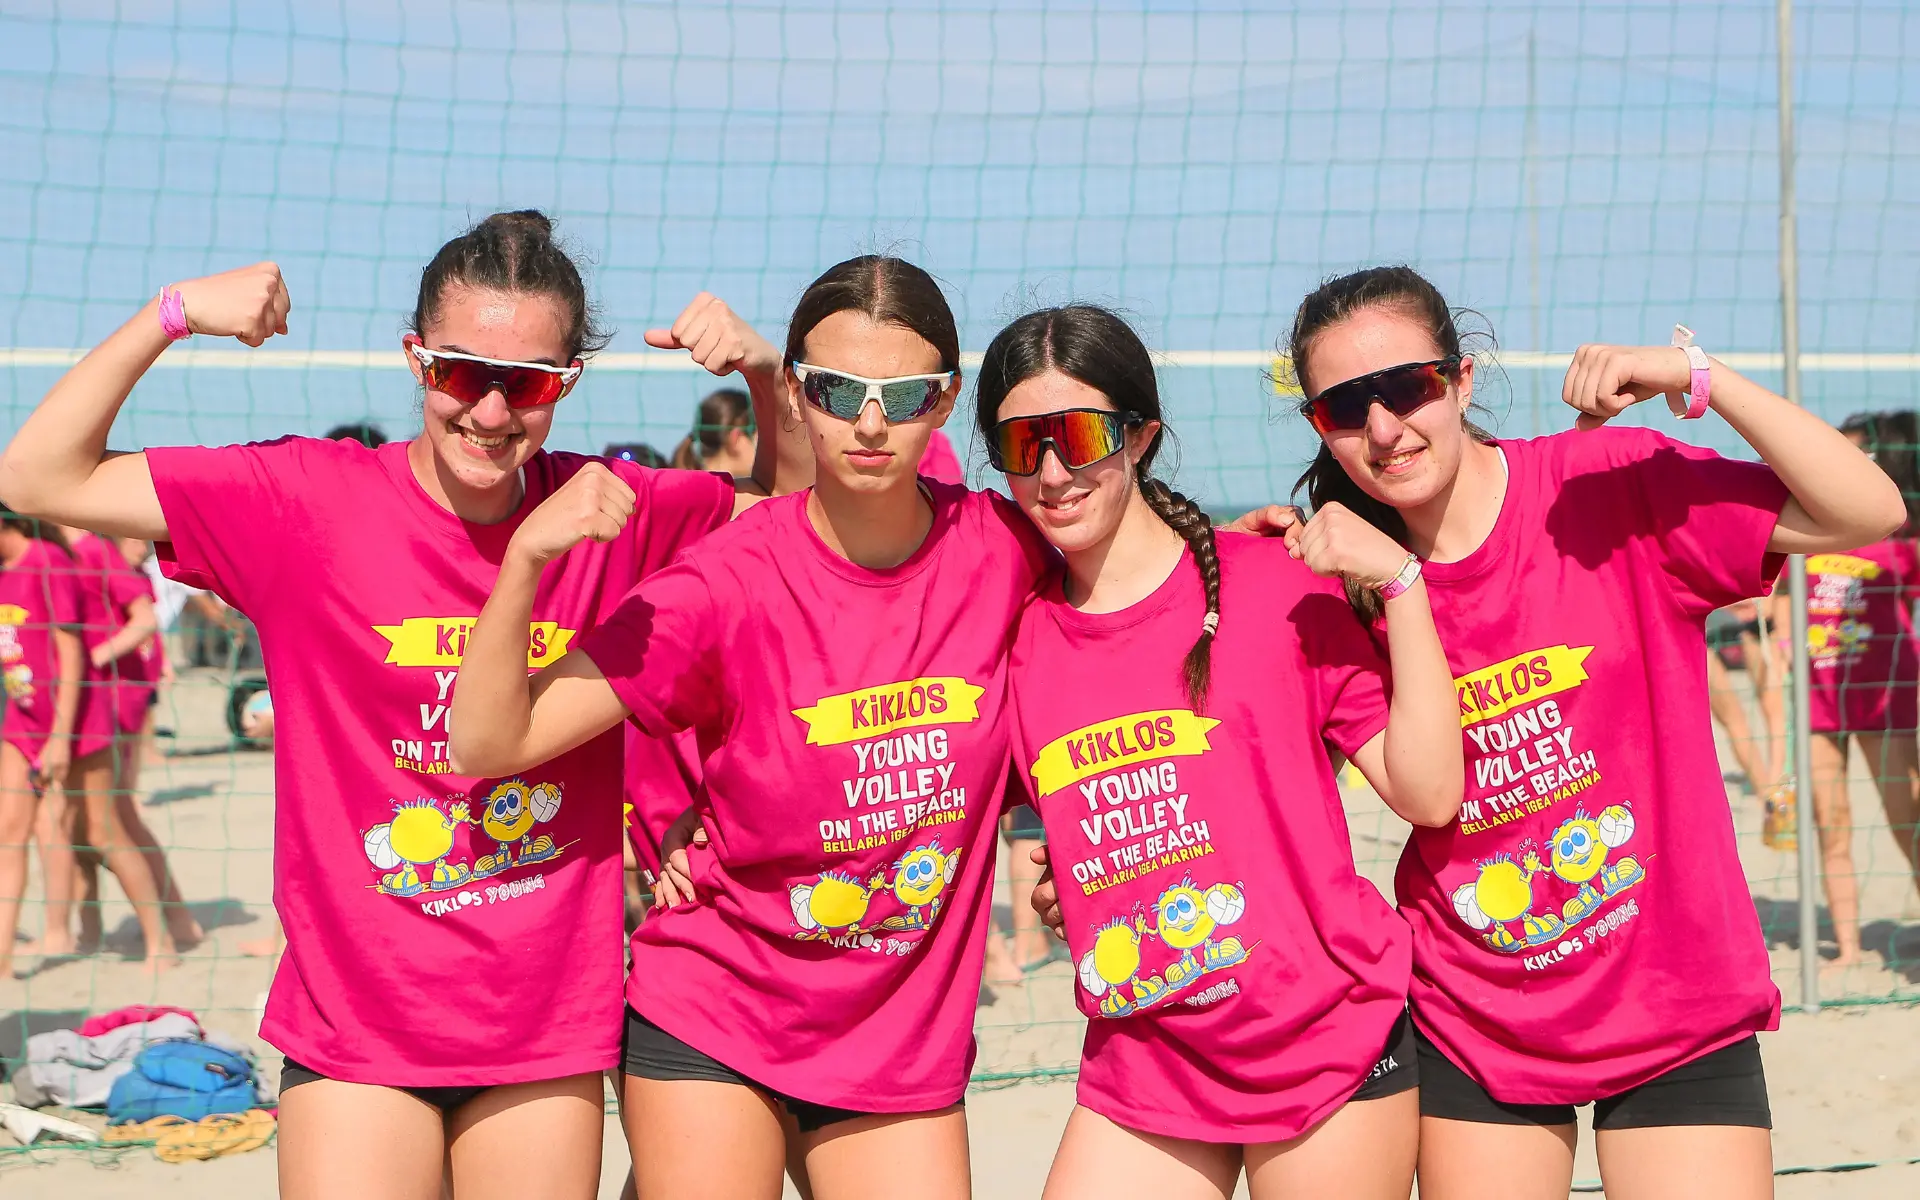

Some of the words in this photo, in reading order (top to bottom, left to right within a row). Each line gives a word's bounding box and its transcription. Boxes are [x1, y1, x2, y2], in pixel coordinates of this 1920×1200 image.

[436, 624, 547, 658] KiS
[391, 739, 423, 761] ON
[852, 728, 949, 774] YOUNG
[1465, 699, 1562, 754] YOUNG
[1474, 726, 1574, 789] VOLLEY
[1485, 784, 1531, 813] THE
[1529, 749, 1597, 796] BEACH
[842, 762, 957, 808] VOLLEY
[1079, 761, 1178, 812] YOUNG
[819, 819, 851, 840] ON
[857, 809, 898, 835] THE
[902, 788, 966, 825] BEACH
[1079, 793, 1190, 846] VOLLEY
[1071, 857, 1106, 883] ON
[1108, 843, 1144, 870] THE
[1145, 819, 1210, 859] BEACH
[421, 891, 482, 917] KIKLOS
[485, 873, 546, 904] YOUNG
[1523, 937, 1584, 971] KIKLOS
[1583, 898, 1640, 944] YOUNG
